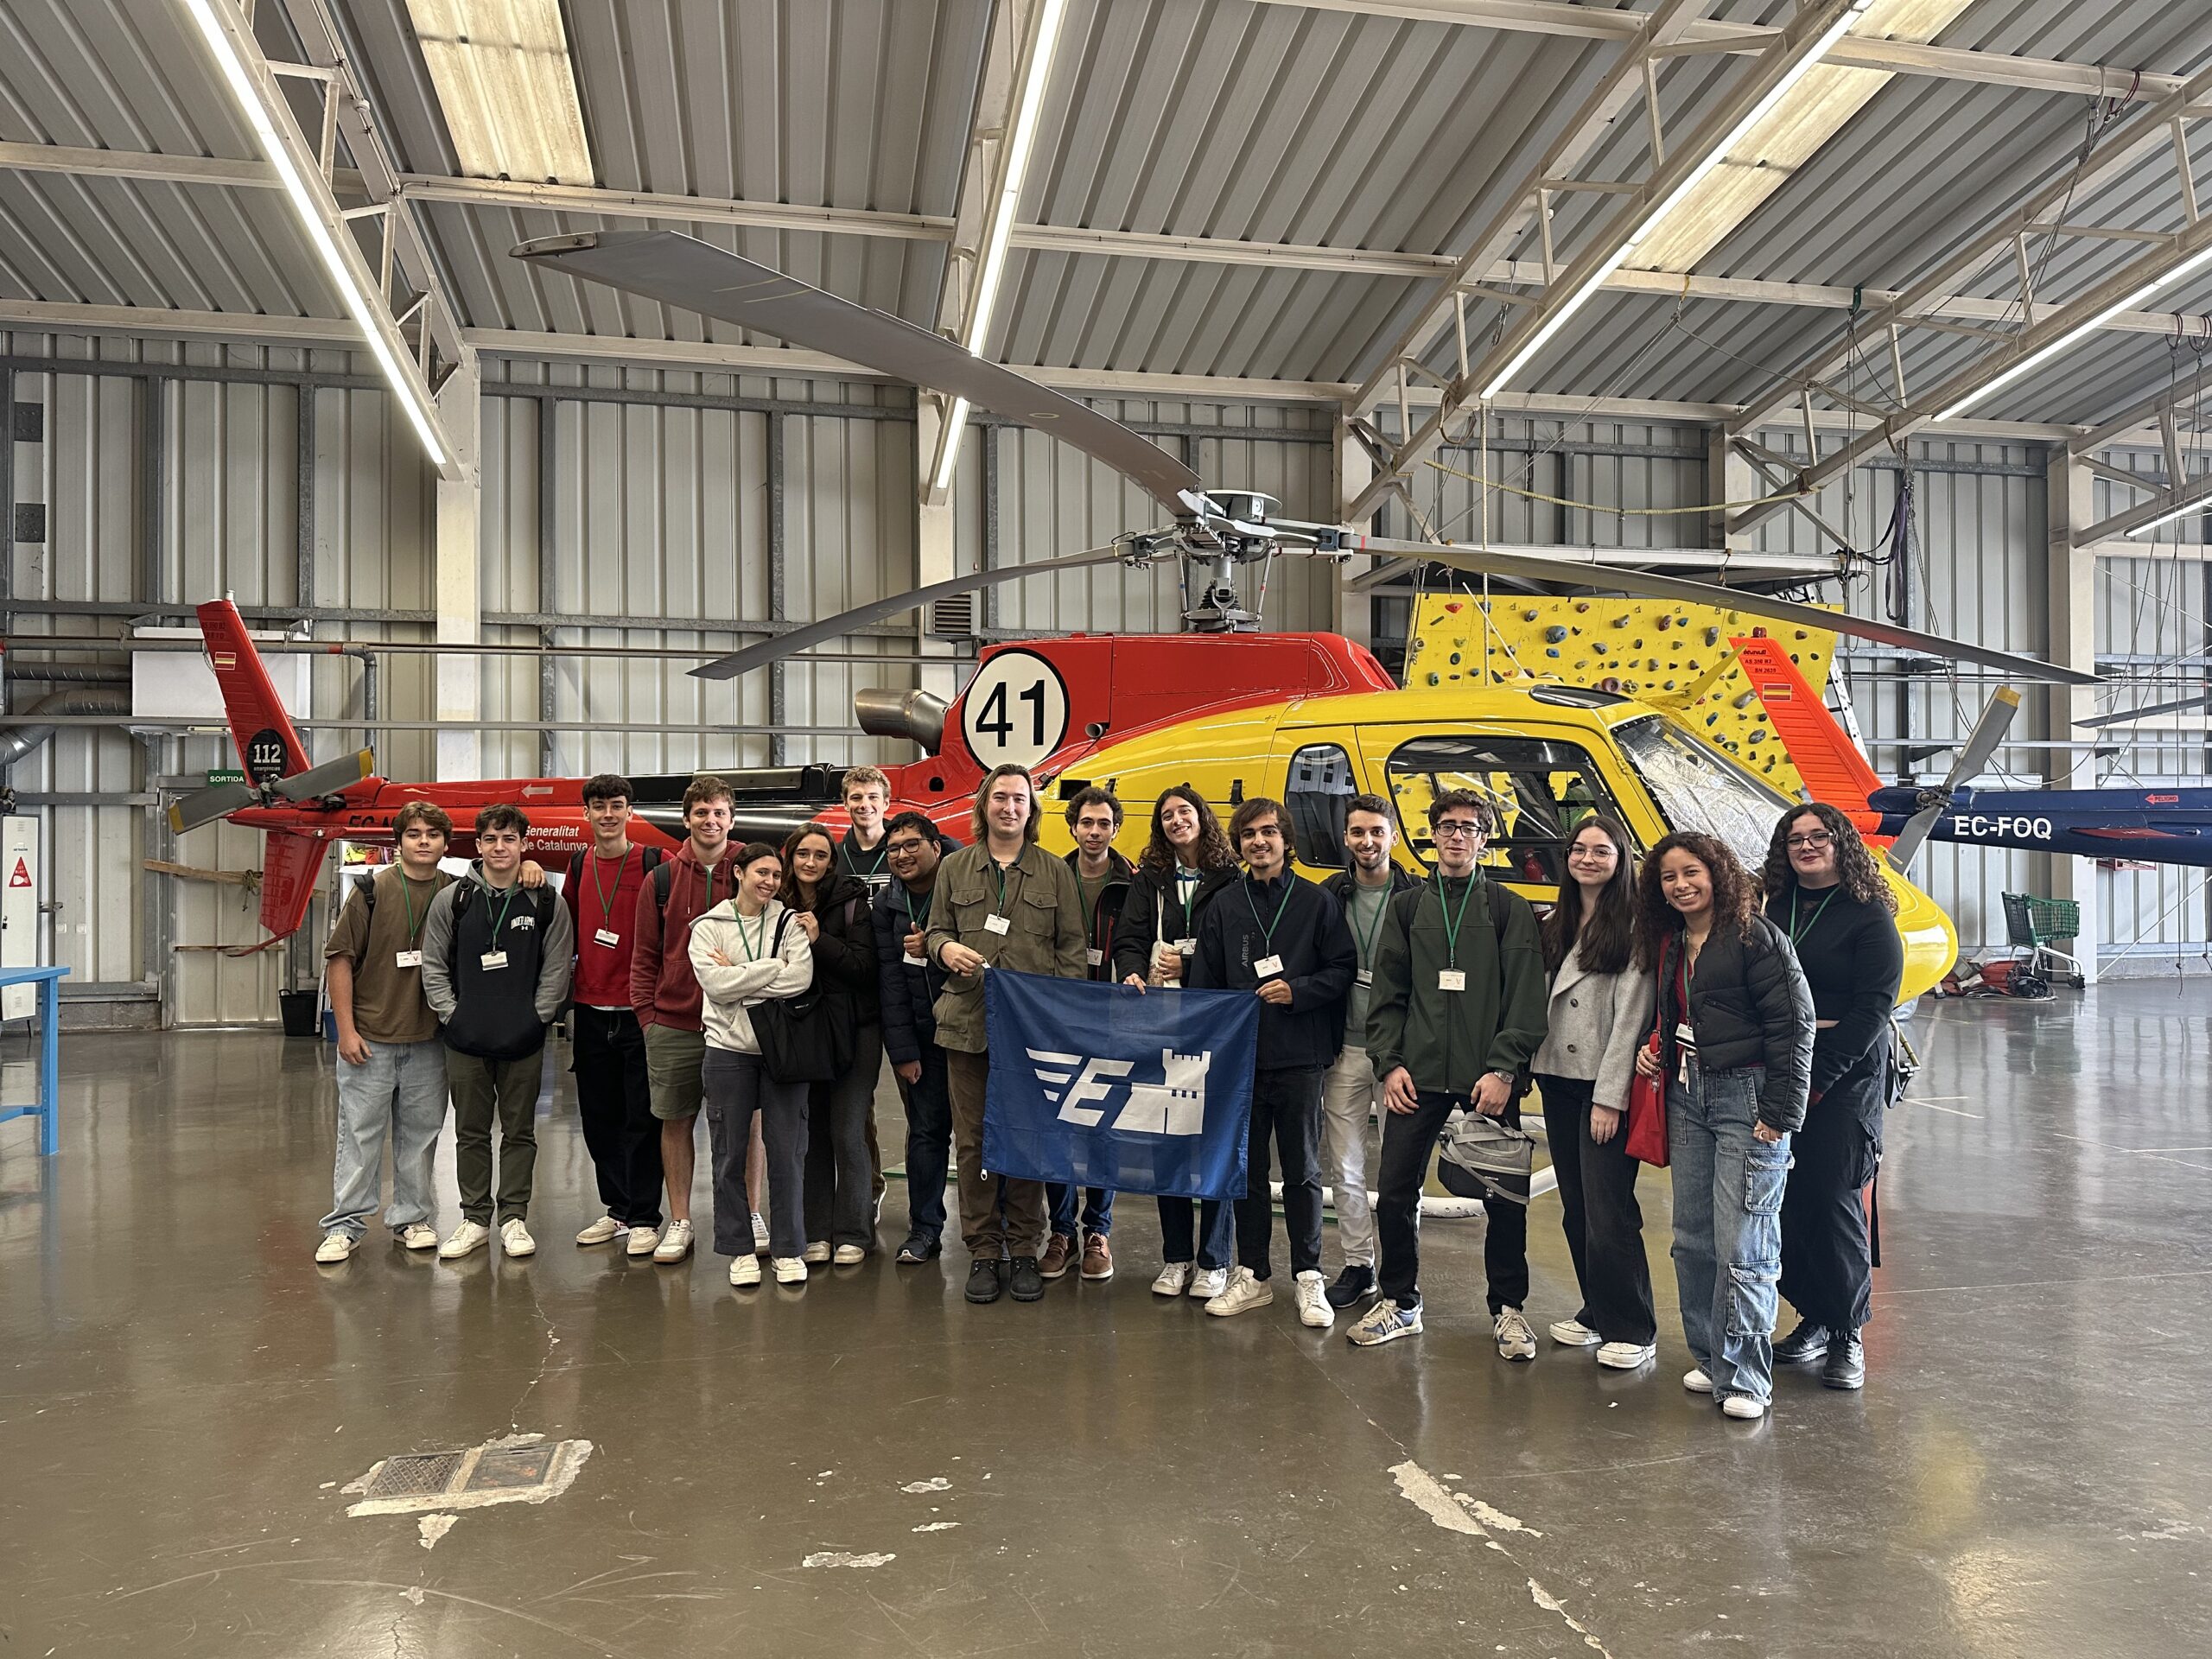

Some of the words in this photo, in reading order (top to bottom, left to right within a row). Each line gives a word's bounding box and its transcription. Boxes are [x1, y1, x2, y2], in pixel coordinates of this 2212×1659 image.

[976, 679, 1045, 747] 41
[253, 743, 281, 764] 112
[1954, 815, 2052, 840] EC-FOQ
[537, 838, 588, 851] Catalunya
